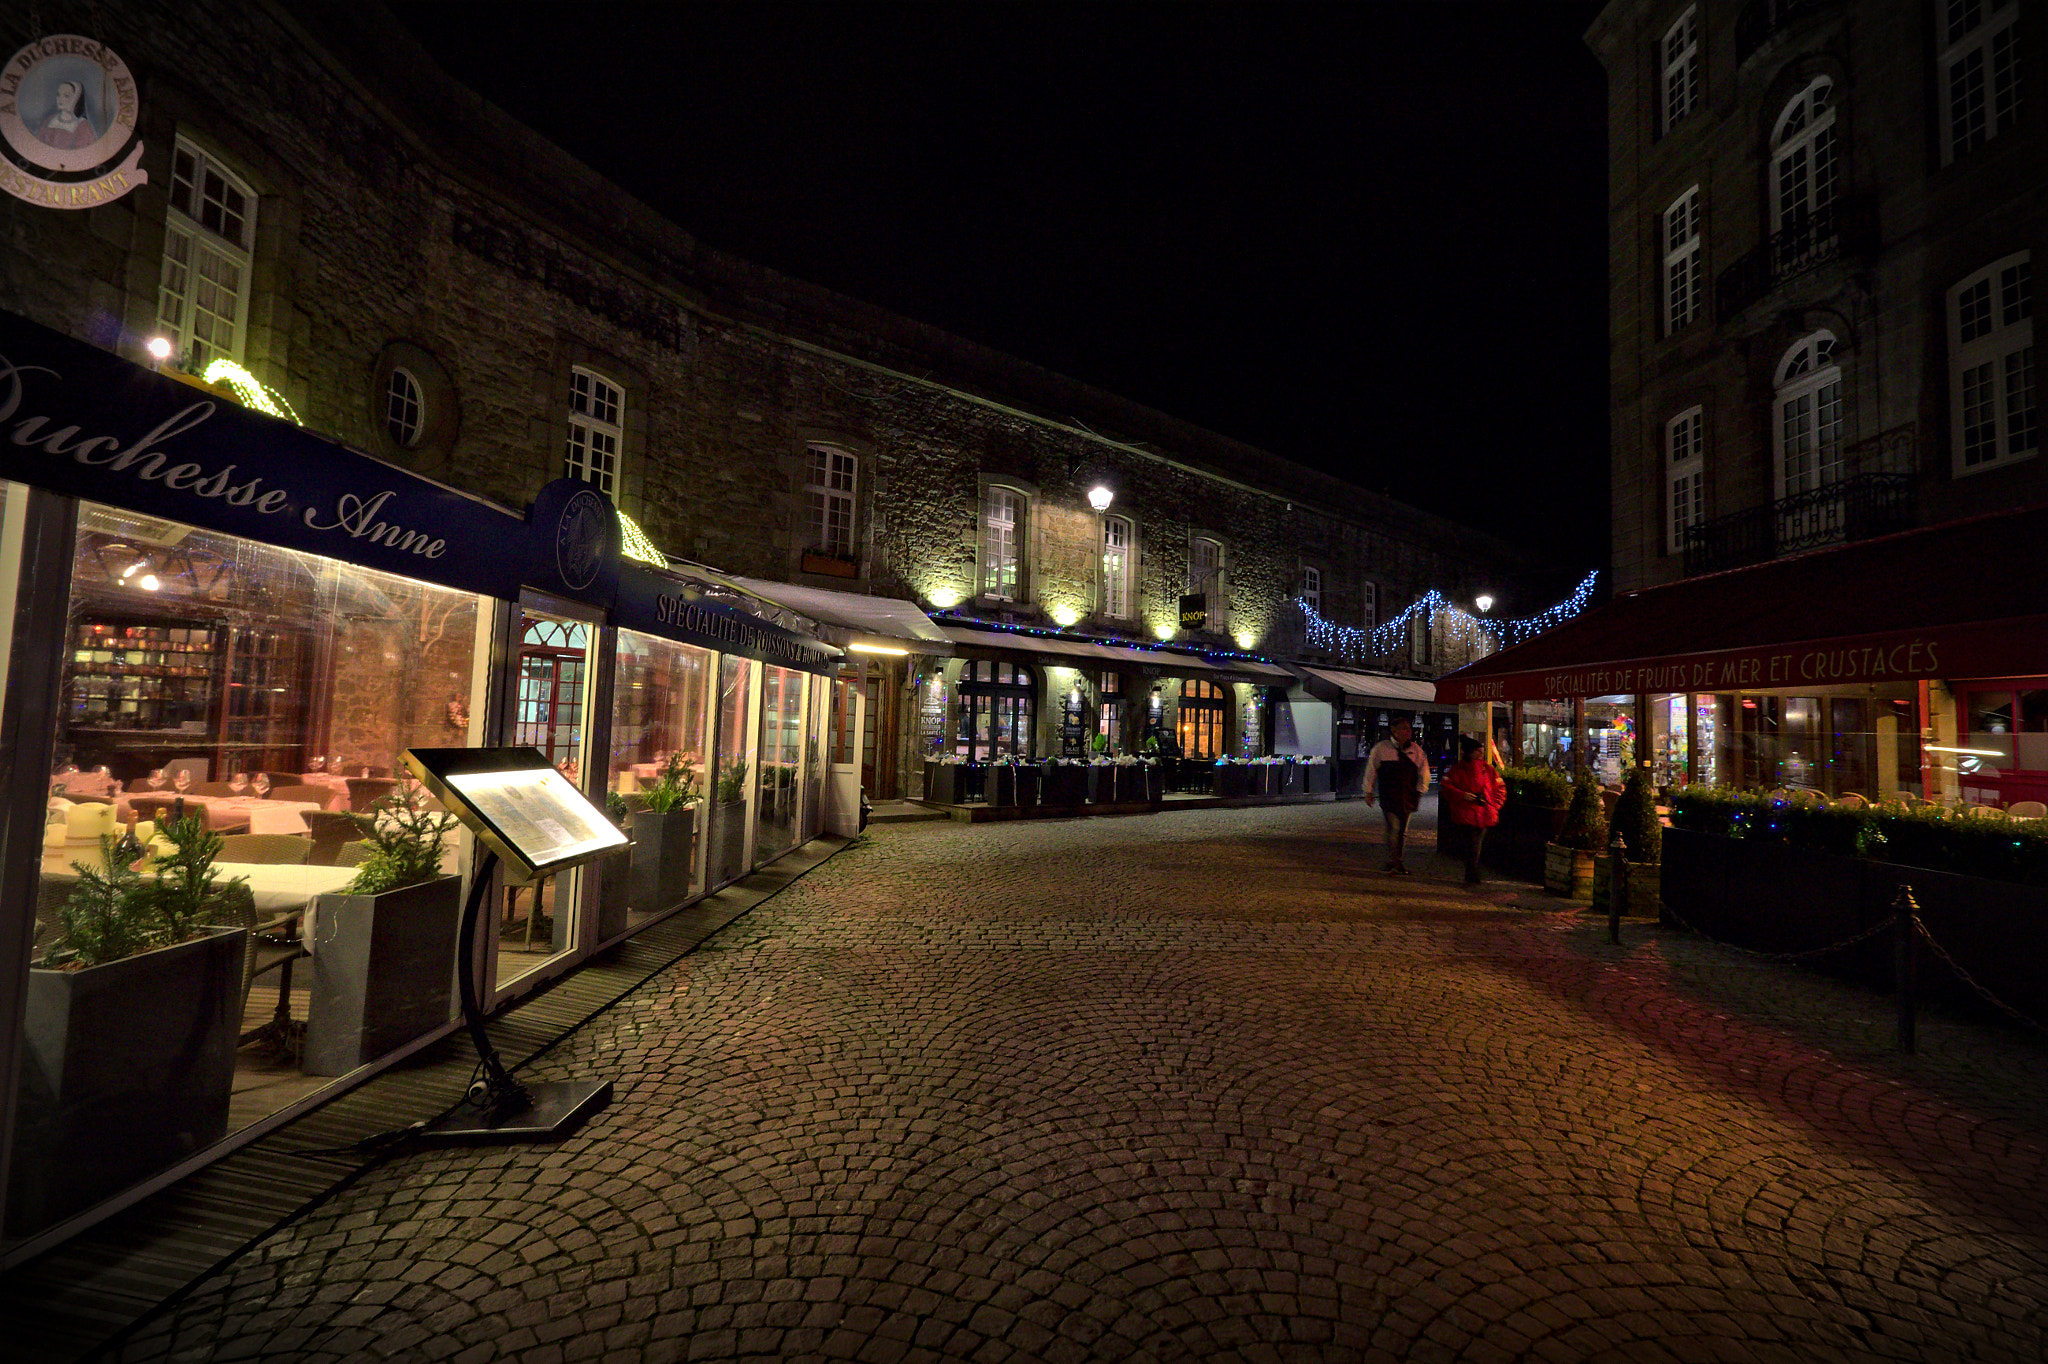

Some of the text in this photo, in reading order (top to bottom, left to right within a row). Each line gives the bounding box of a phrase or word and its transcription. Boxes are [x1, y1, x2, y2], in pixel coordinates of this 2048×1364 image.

[1, 72, 21, 97] LA
[17, 37, 118, 72] DUCHESSE
[113, 76, 134, 130] ANNE
[0, 160, 130, 206] ESTAURANT
[303, 490, 448, 560] Anne
[657, 593, 737, 642] SPÉCIALITÉ
[739, 623, 755, 648] DE
[757, 629, 795, 661] POISSONS
[1465, 681, 1504, 700] BRASSERIE
[1544, 638, 1939, 695] SPÉCIALITÉS DE FRUITS DE MER ET CRUSTACÉS
